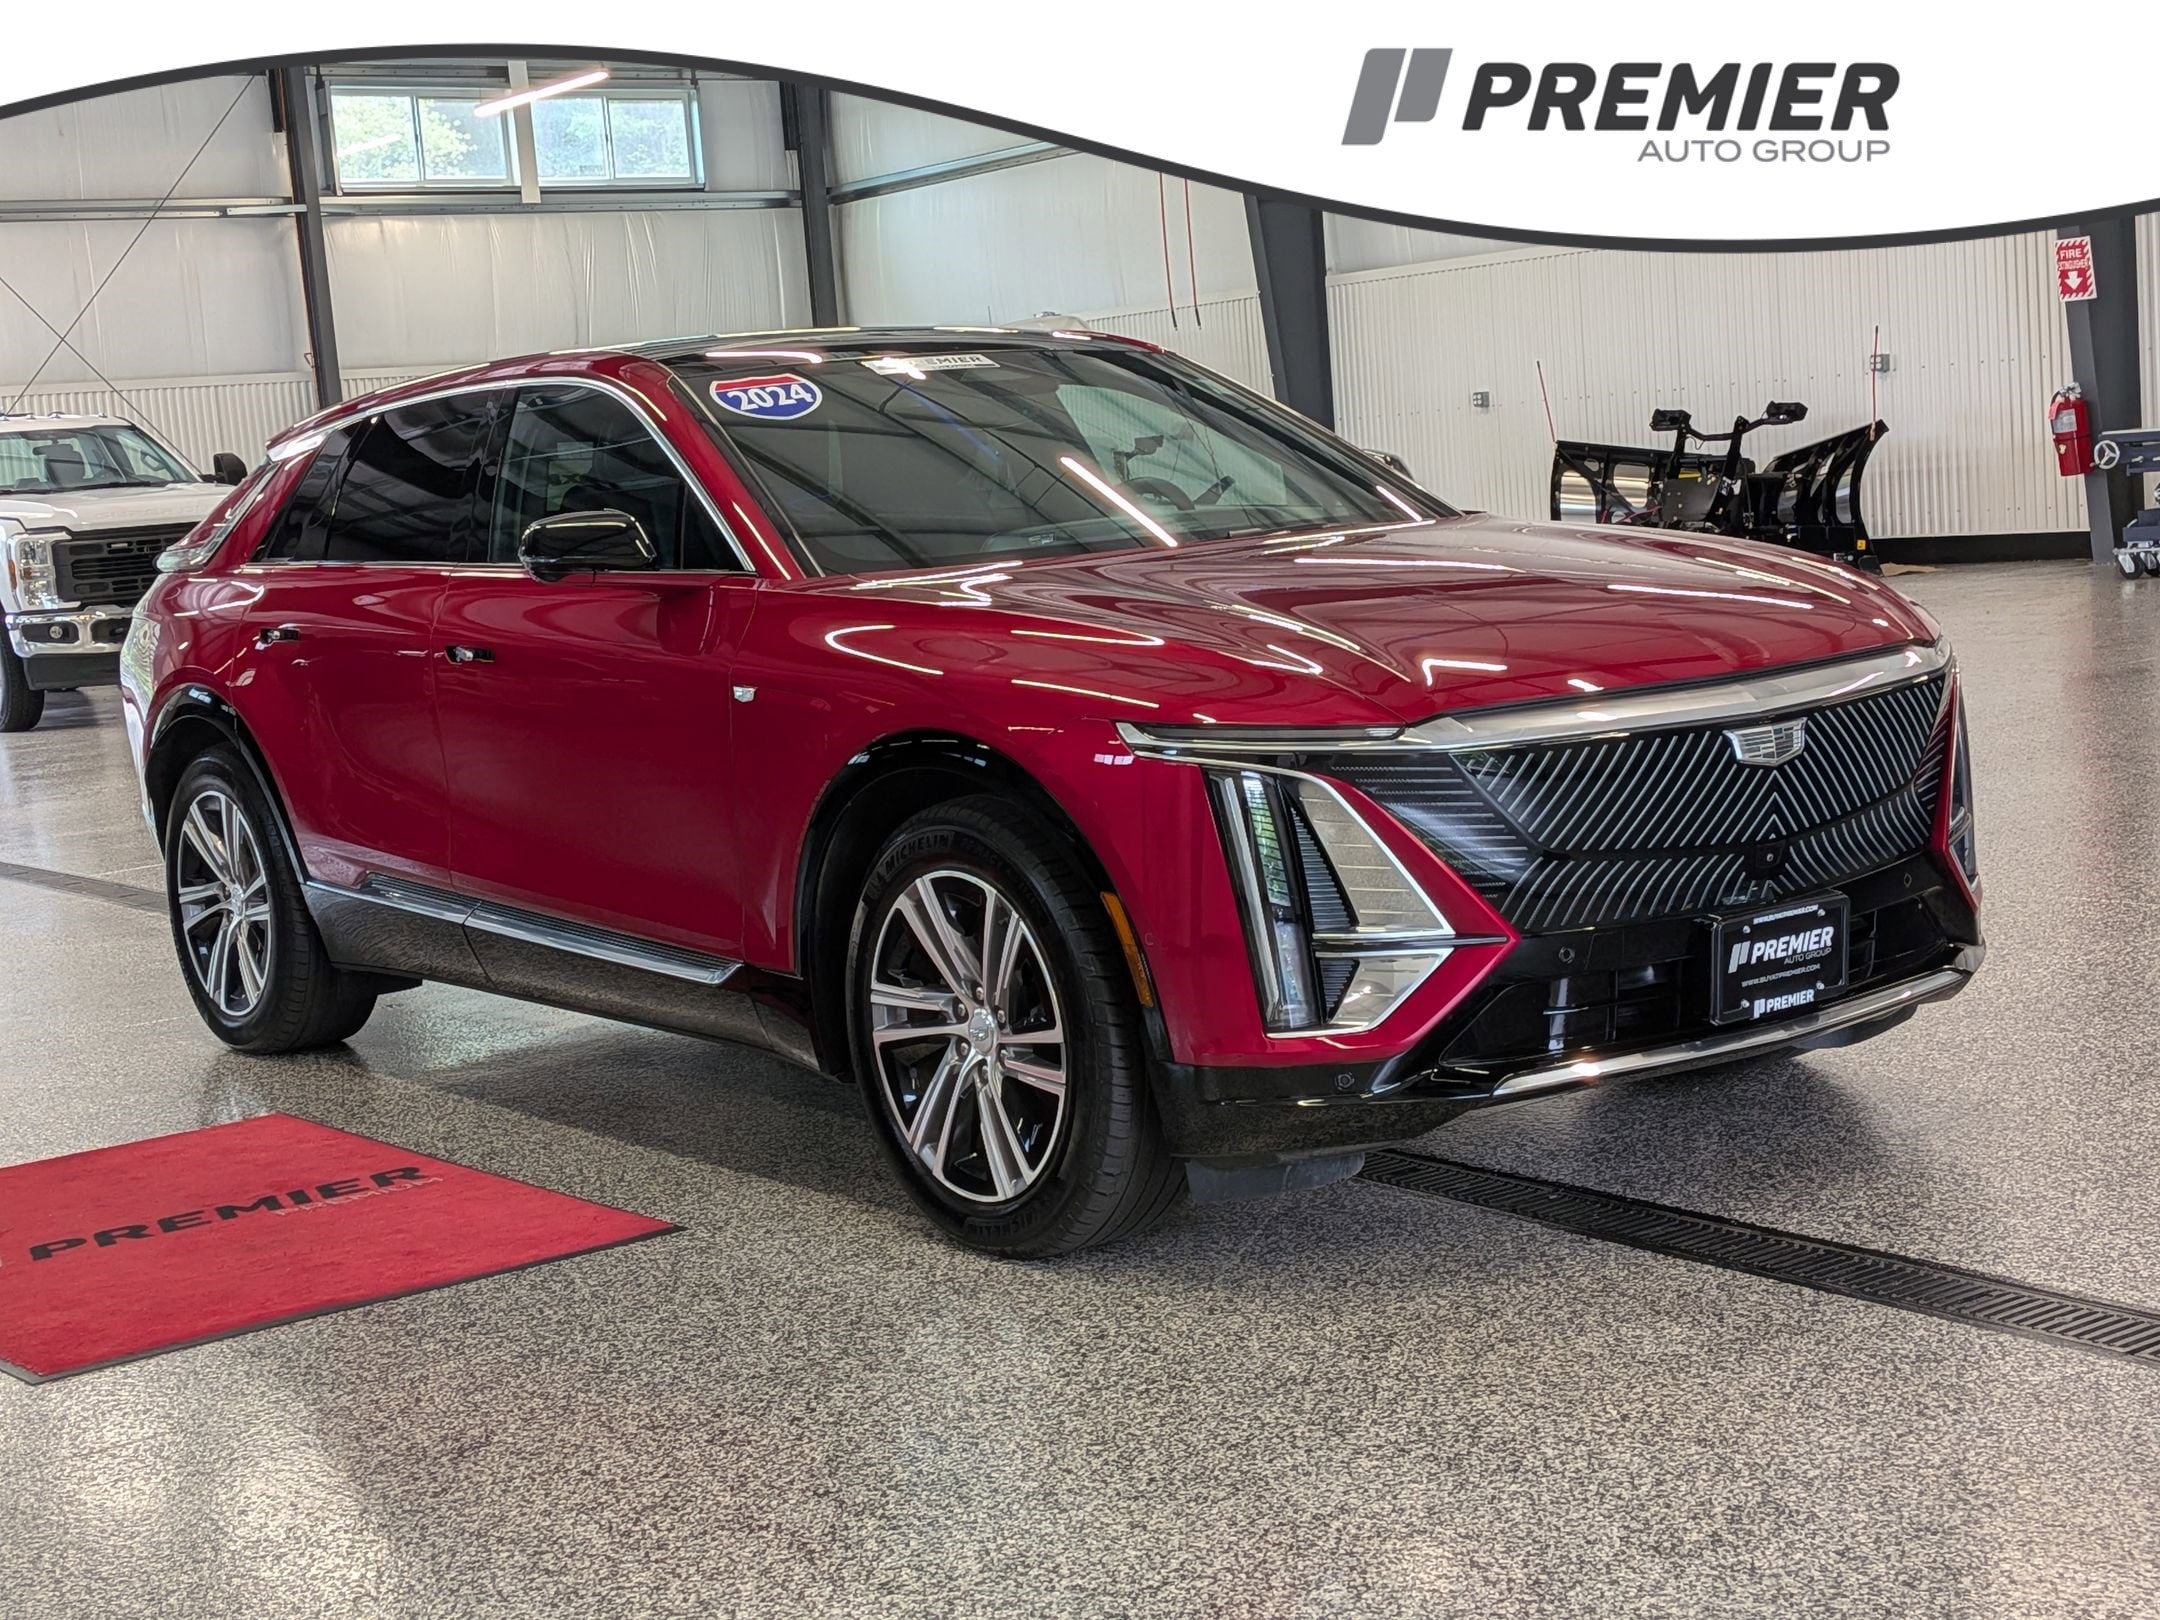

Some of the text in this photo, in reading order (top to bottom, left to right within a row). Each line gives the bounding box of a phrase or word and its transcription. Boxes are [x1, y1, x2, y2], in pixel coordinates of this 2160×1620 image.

[2060, 247, 2082, 259] FIRE
[727, 382, 814, 411] 2024
[884, 831, 953, 877] MICHELIN
[1751, 926, 1834, 964] PREMIER
[1783, 947, 1832, 965] AUTO GROUP
[1766, 989, 1815, 1013] PREMIER
[29, 1165, 430, 1261] PREMIER
